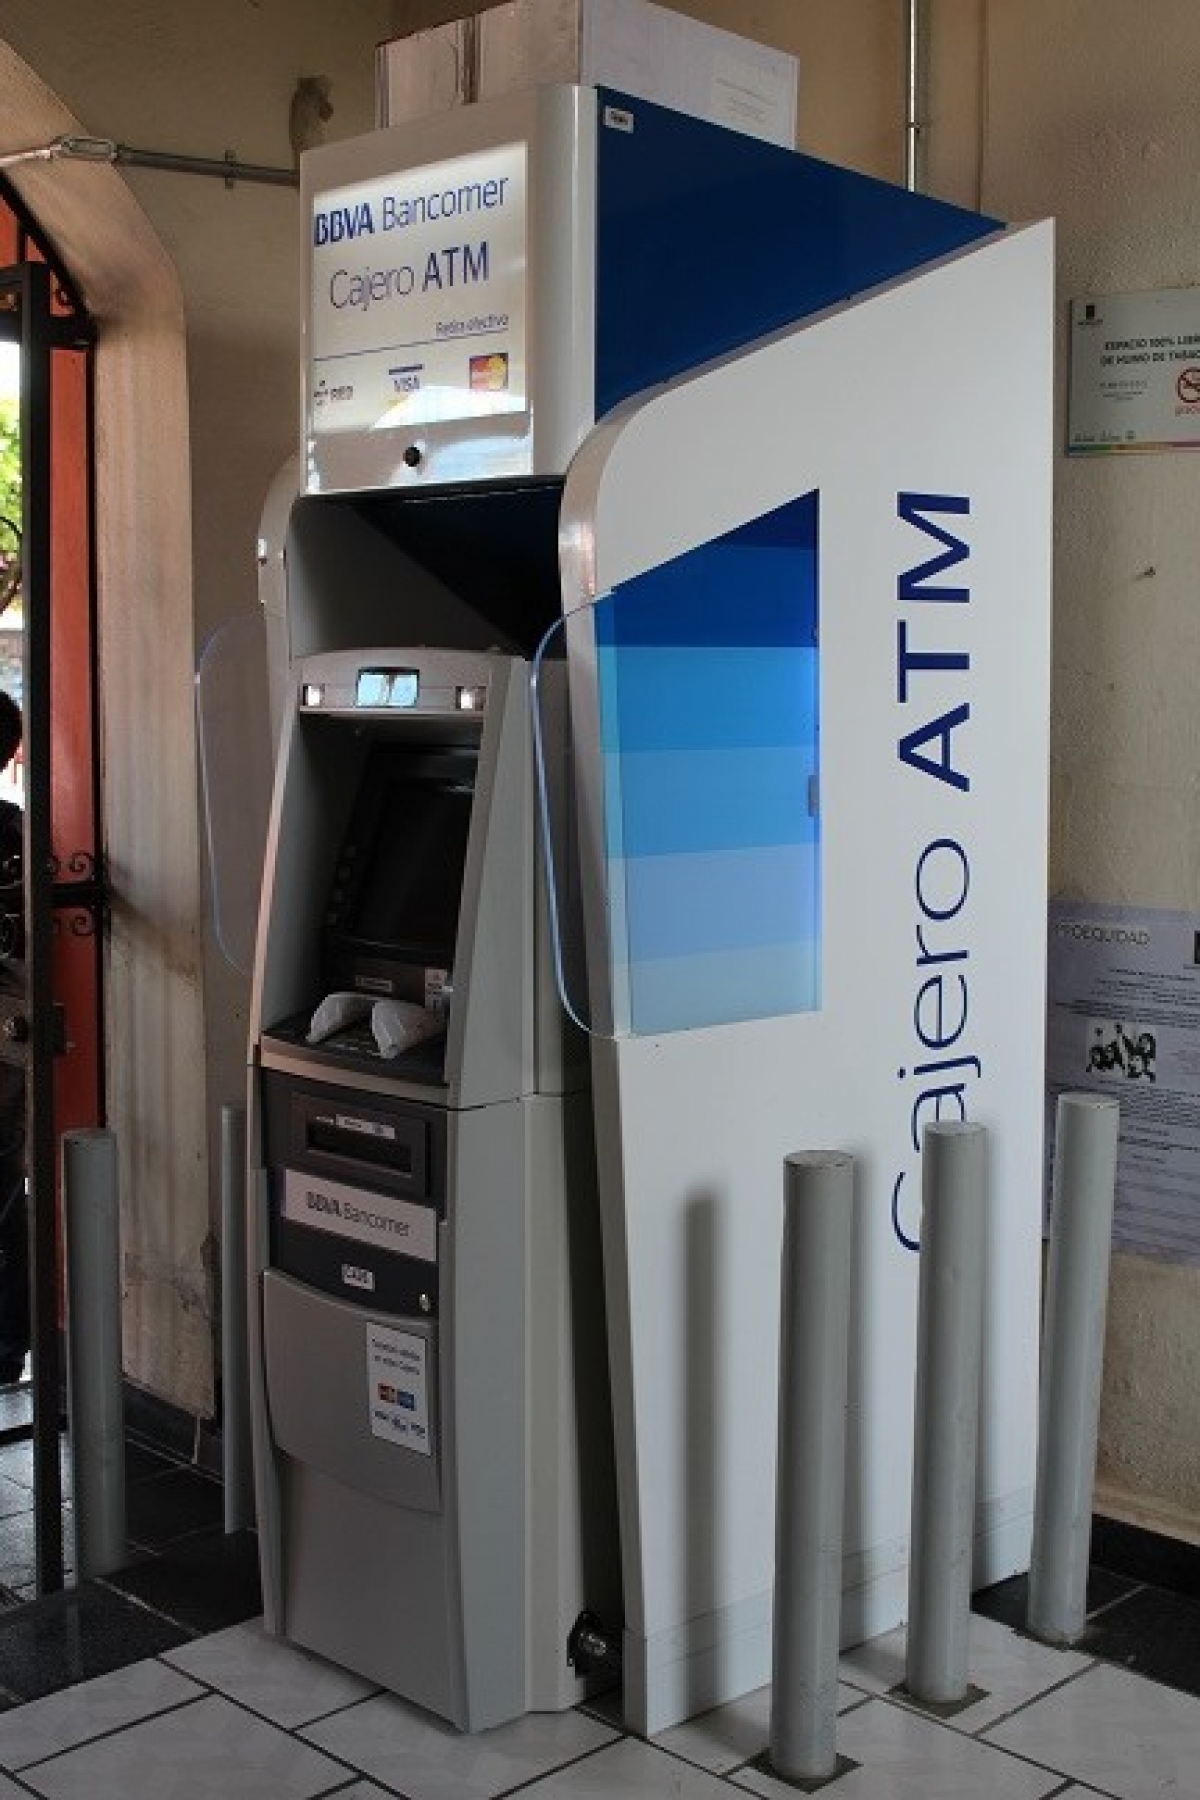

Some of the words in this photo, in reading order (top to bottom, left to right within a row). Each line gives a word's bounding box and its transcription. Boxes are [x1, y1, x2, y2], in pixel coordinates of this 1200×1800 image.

[313, 202, 375, 247] BBVA
[382, 177, 509, 231] Bancomer
[330, 266, 414, 311] Cajero
[422, 241, 490, 292] ATM
[897, 491, 970, 792] ATM
[344, 1202, 409, 1237] Bancomer
